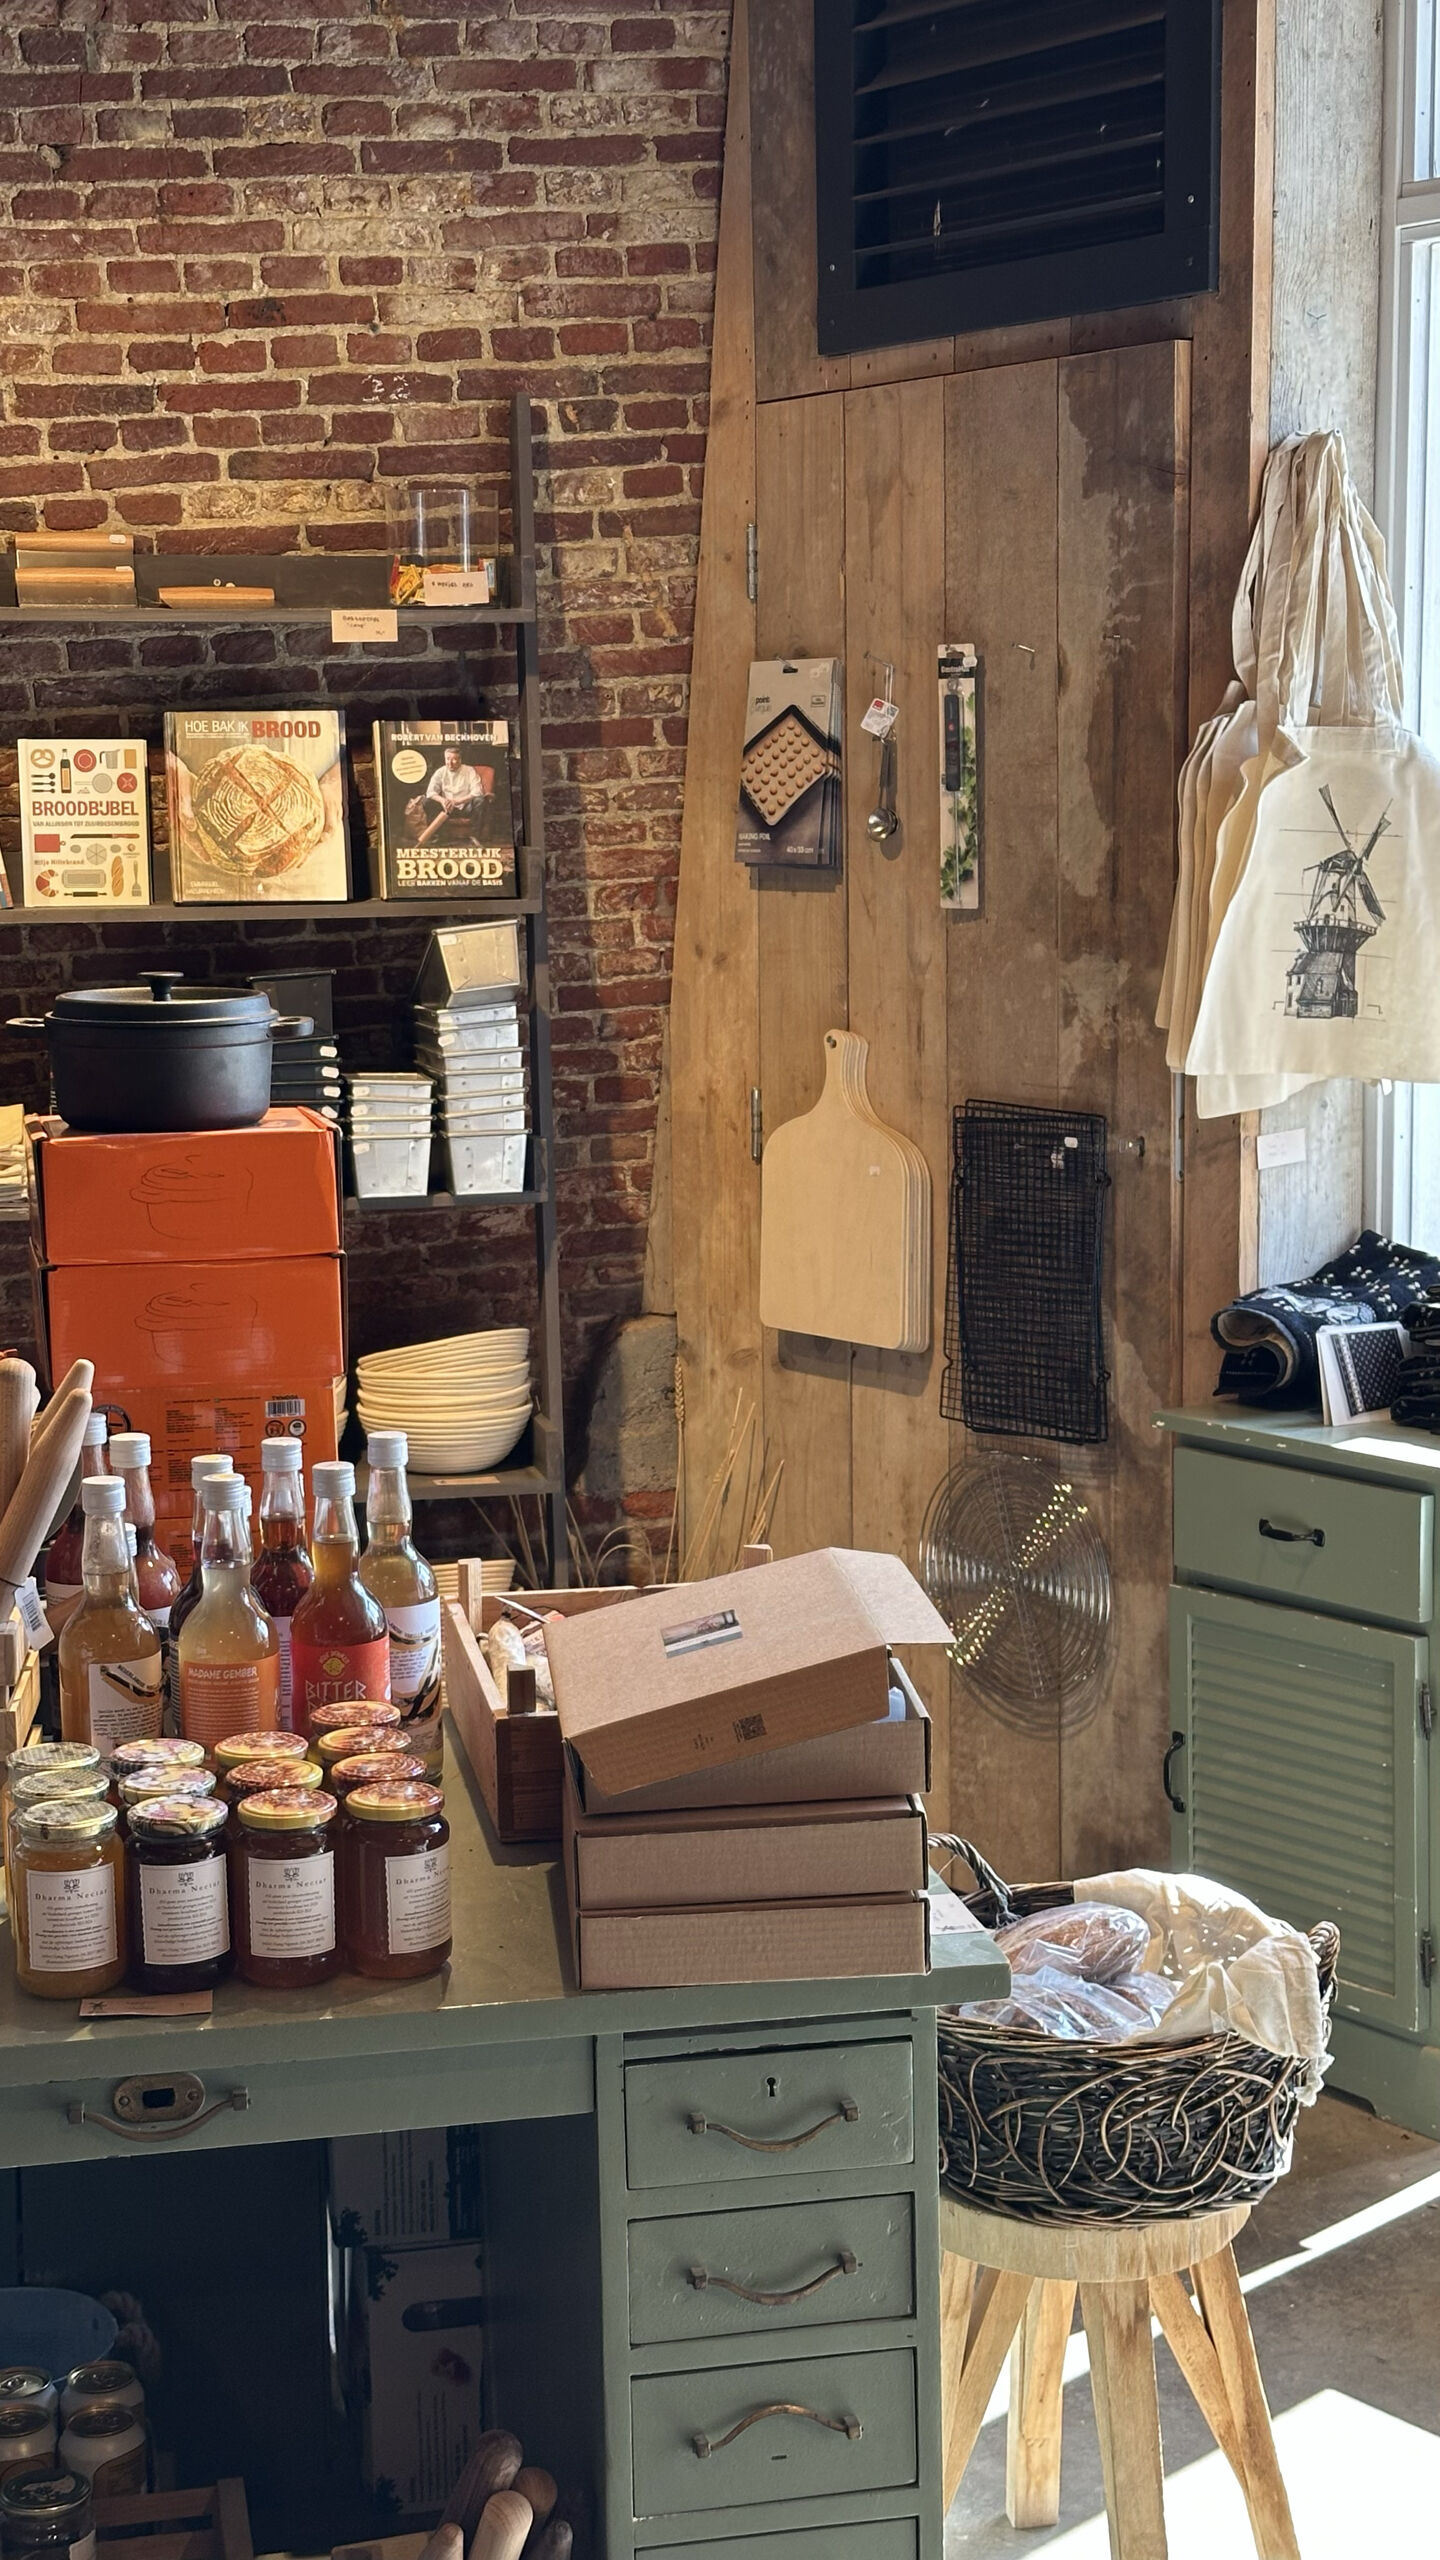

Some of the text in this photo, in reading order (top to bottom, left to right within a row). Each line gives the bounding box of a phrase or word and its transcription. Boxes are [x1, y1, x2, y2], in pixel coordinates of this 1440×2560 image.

[185, 720, 208, 733] HOE
[212, 720, 235, 733] BAK
[238, 720, 249, 733] IK
[252, 720, 321, 738] BROOD
[391, 732, 497, 742] ROBERT VAN BECKHOVEN
[32, 800, 140, 816] BROODBIJBEL
[396, 847, 502, 859] MEESTERLIJK
[396, 859, 503, 879] BROOD
[416, 879, 446, 887] BAKKEN
[187, 1665, 258, 1680] MADAME GEMBER
[305, 1679, 367, 1702] BITTER
[255, 1877, 327, 1889] Dharma Nectar
[395, 1874, 431, 1885] Dharma
[35, 1888, 108, 1901] Dharma Nectar
[149, 1881, 220, 1895] Dharma Nectar
